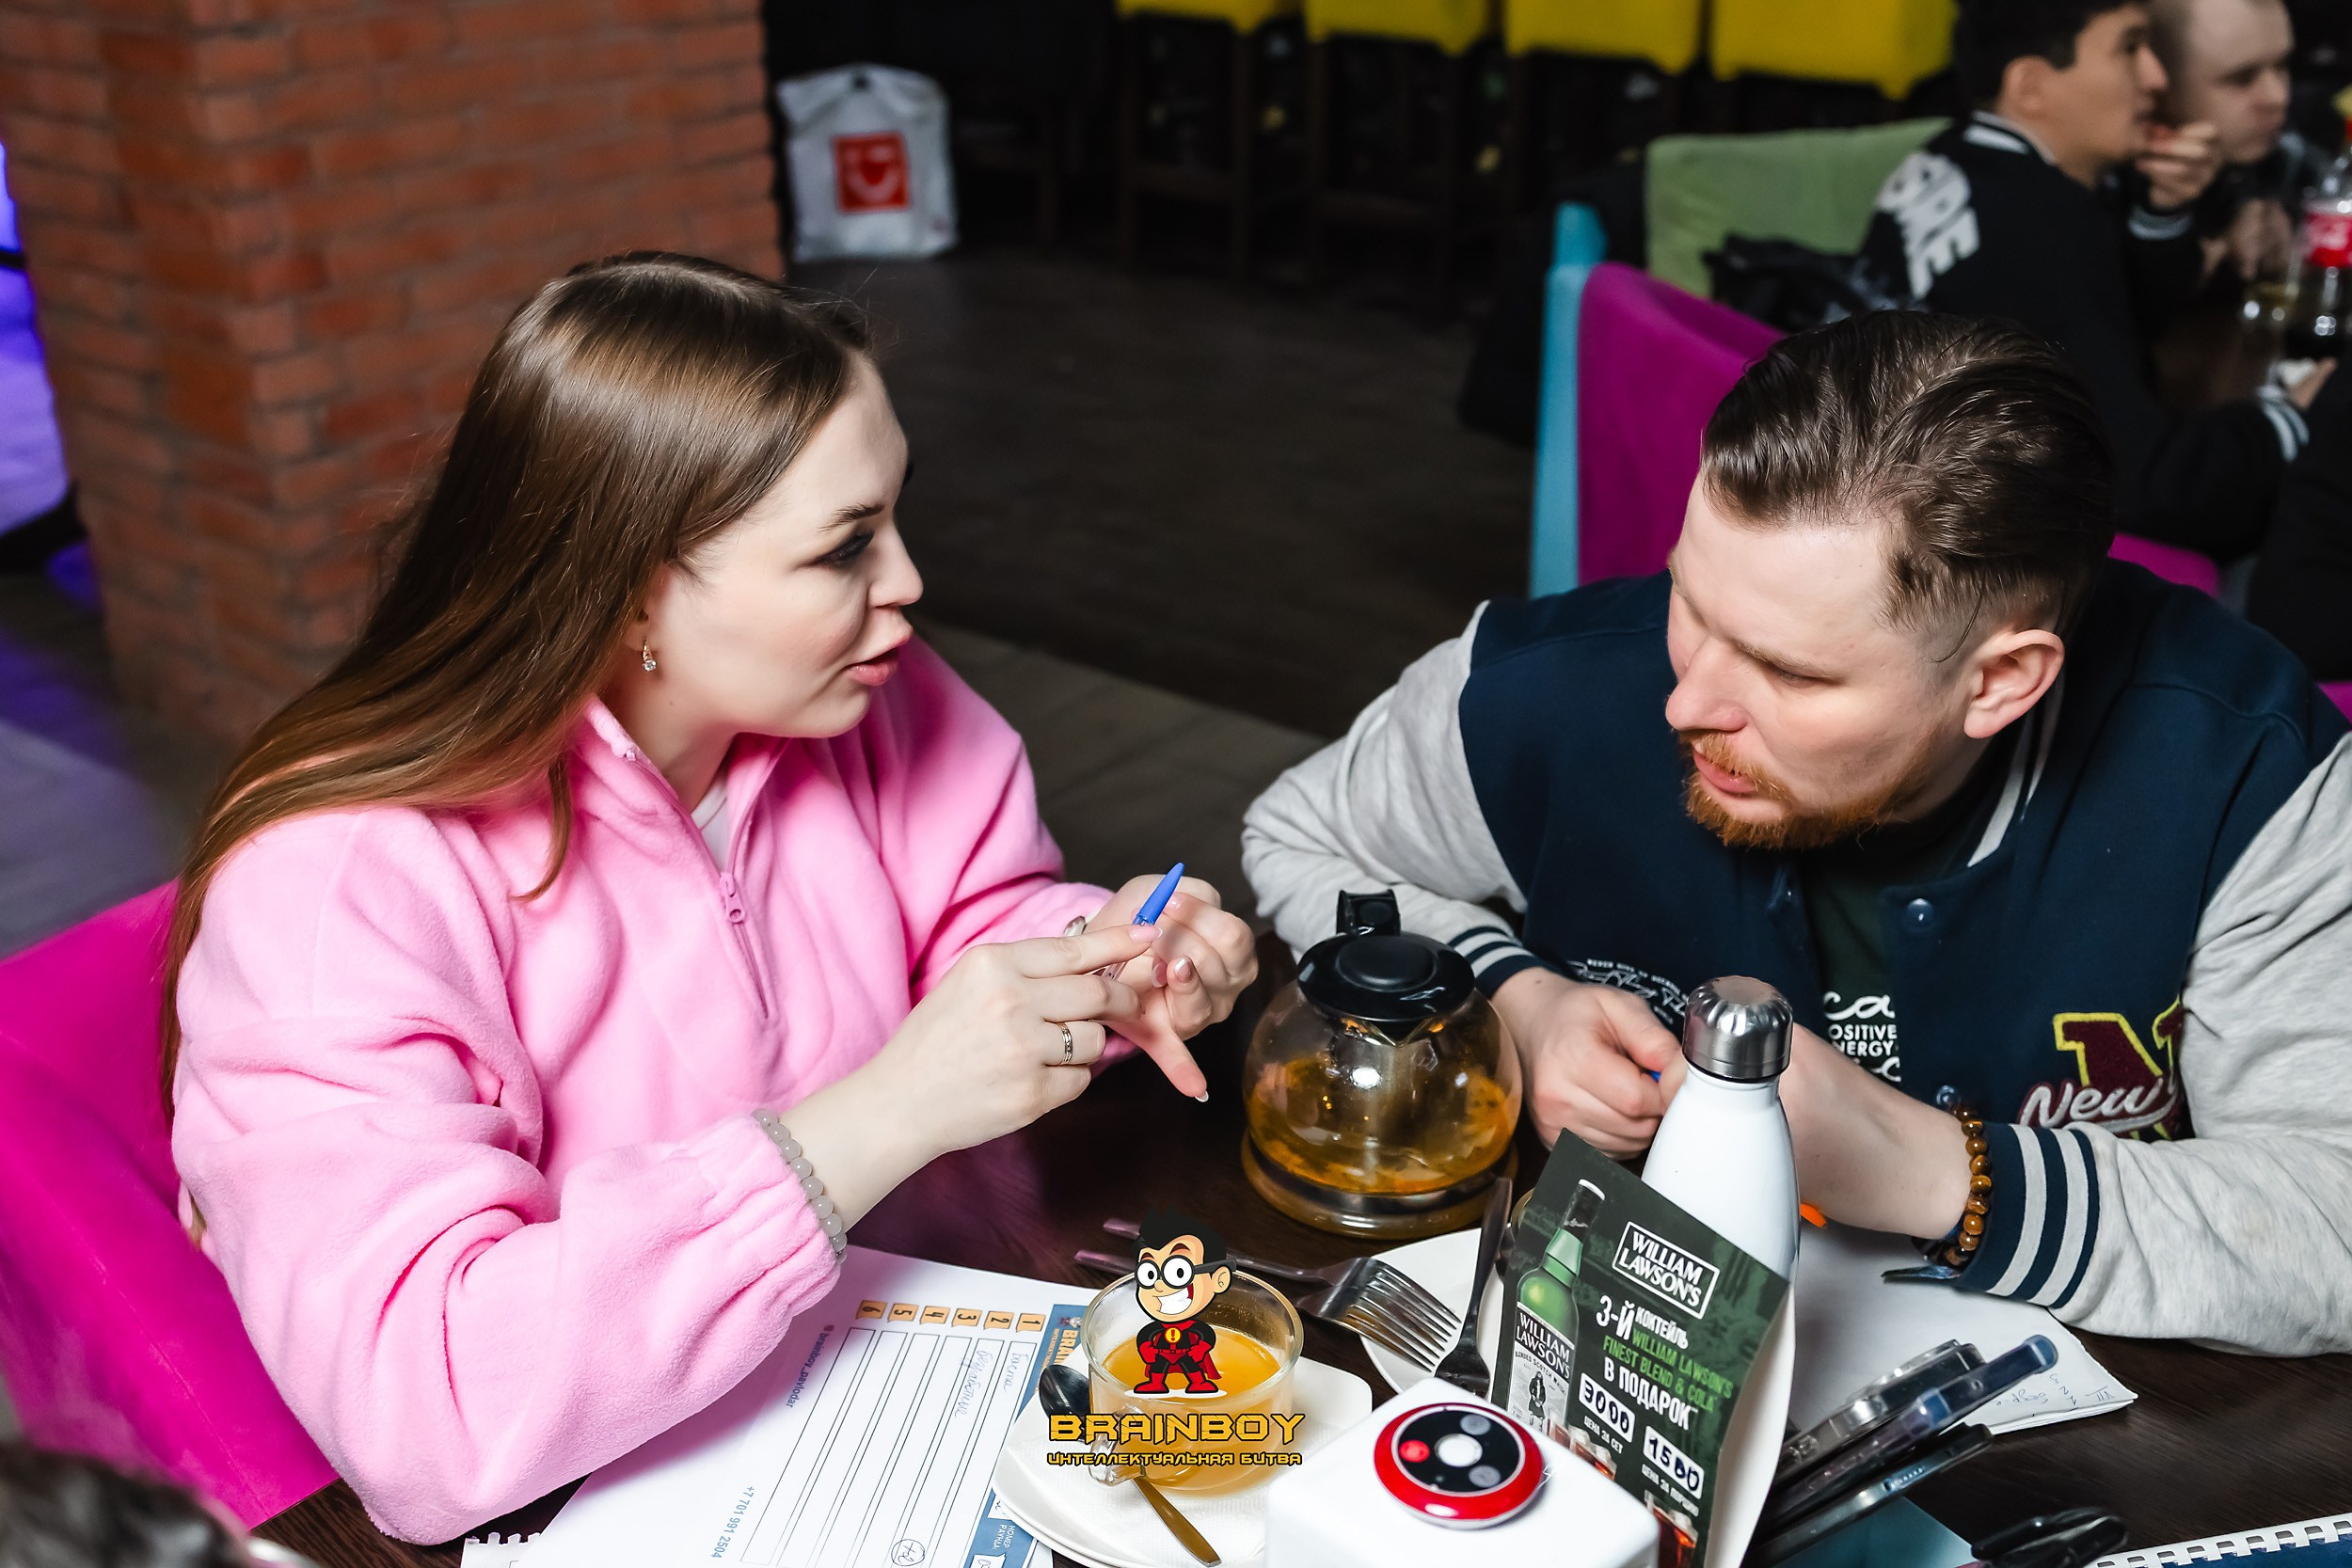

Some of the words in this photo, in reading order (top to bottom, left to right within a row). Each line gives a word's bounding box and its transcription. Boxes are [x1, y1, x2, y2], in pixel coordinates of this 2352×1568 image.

[1828, 1023, 1898, 1040] OSITIVE
[1833, 1039, 1894, 1056] NERGY
[2020, 1082, 2164, 1128] New
[1618, 1247, 1702, 1307] LAWSON'S
[1632, 1230, 1704, 1286] WILLIAM
[991, 1316, 1009, 1324] 2
[1519, 1312, 1570, 1363] WILLIAM
[1635, 1306, 1689, 1349] КОКТЕЙЛЬ
[786, 1332, 830, 1409] brainboy_pavlodar
[1517, 1325, 1570, 1379] LAWSON'S
[1602, 1335, 1639, 1368] FINEST
[1640, 1356, 1674, 1388] BLEND
[1675, 1378, 1685, 1396] &
[1604, 1356, 1615, 1382] В
[1632, 1327, 1677, 1367] WILLIAM
[1677, 1354, 1734, 1399] LAWSON'S
[1584, 1380, 1629, 1433] 3000
[1611, 1438, 1624, 1454] СЕТ
[1648, 1437, 1700, 1492] 1500
[733, 1499, 750, 1516] 701
[743, 1486, 755, 1497] +7
[711, 1535, 731, 1559] 2504
[723, 1516, 740, 1534] 991
